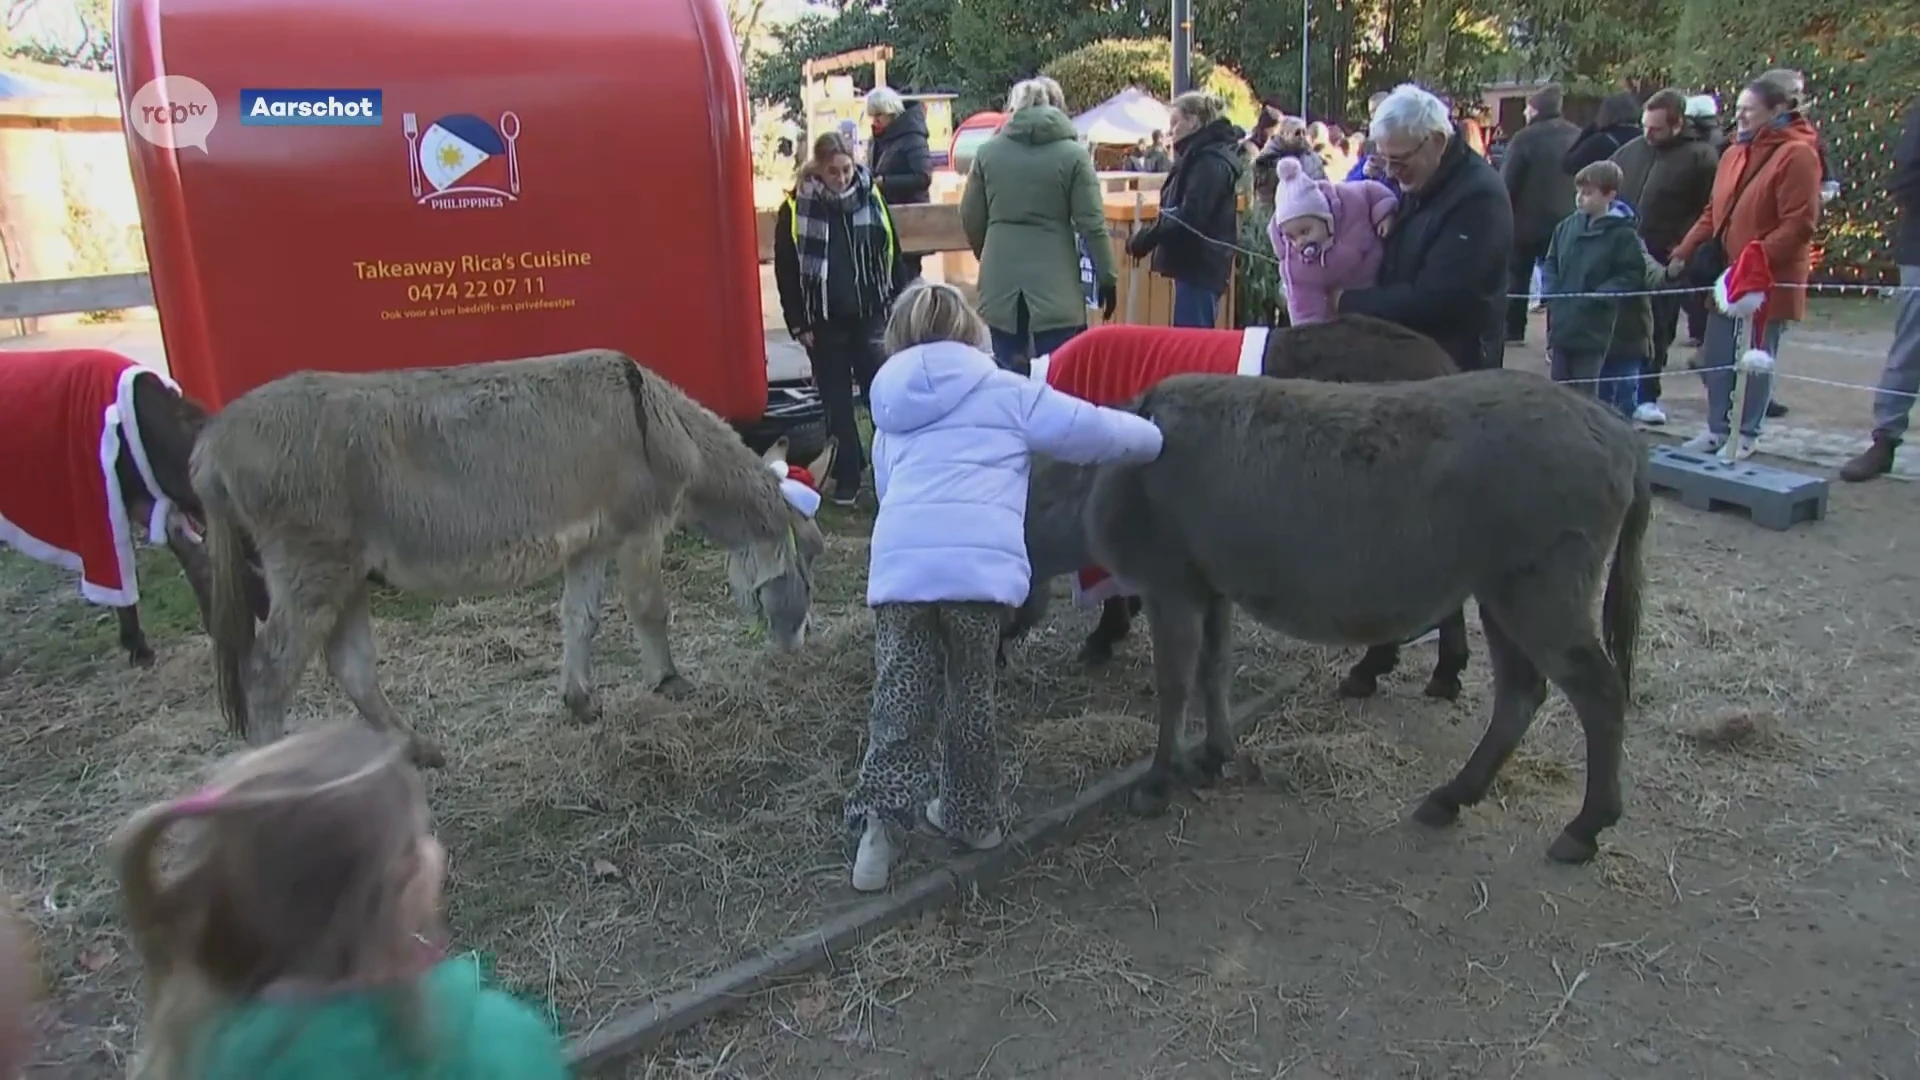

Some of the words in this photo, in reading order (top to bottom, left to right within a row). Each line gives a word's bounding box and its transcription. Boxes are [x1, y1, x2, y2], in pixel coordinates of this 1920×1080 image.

[431, 197, 504, 209] PHILIPPINES
[353, 260, 456, 279] Takeaway
[461, 253, 515, 273] Rica's
[520, 249, 591, 269] Cuisine
[408, 283, 458, 302] 0474
[464, 281, 488, 298] 22
[493, 279, 517, 296] 07
[524, 276, 544, 294] 11
[381, 310, 402, 320] Ook
[404, 309, 427, 318] voor
[429, 306, 438, 317] al
[440, 307, 456, 316] uw
